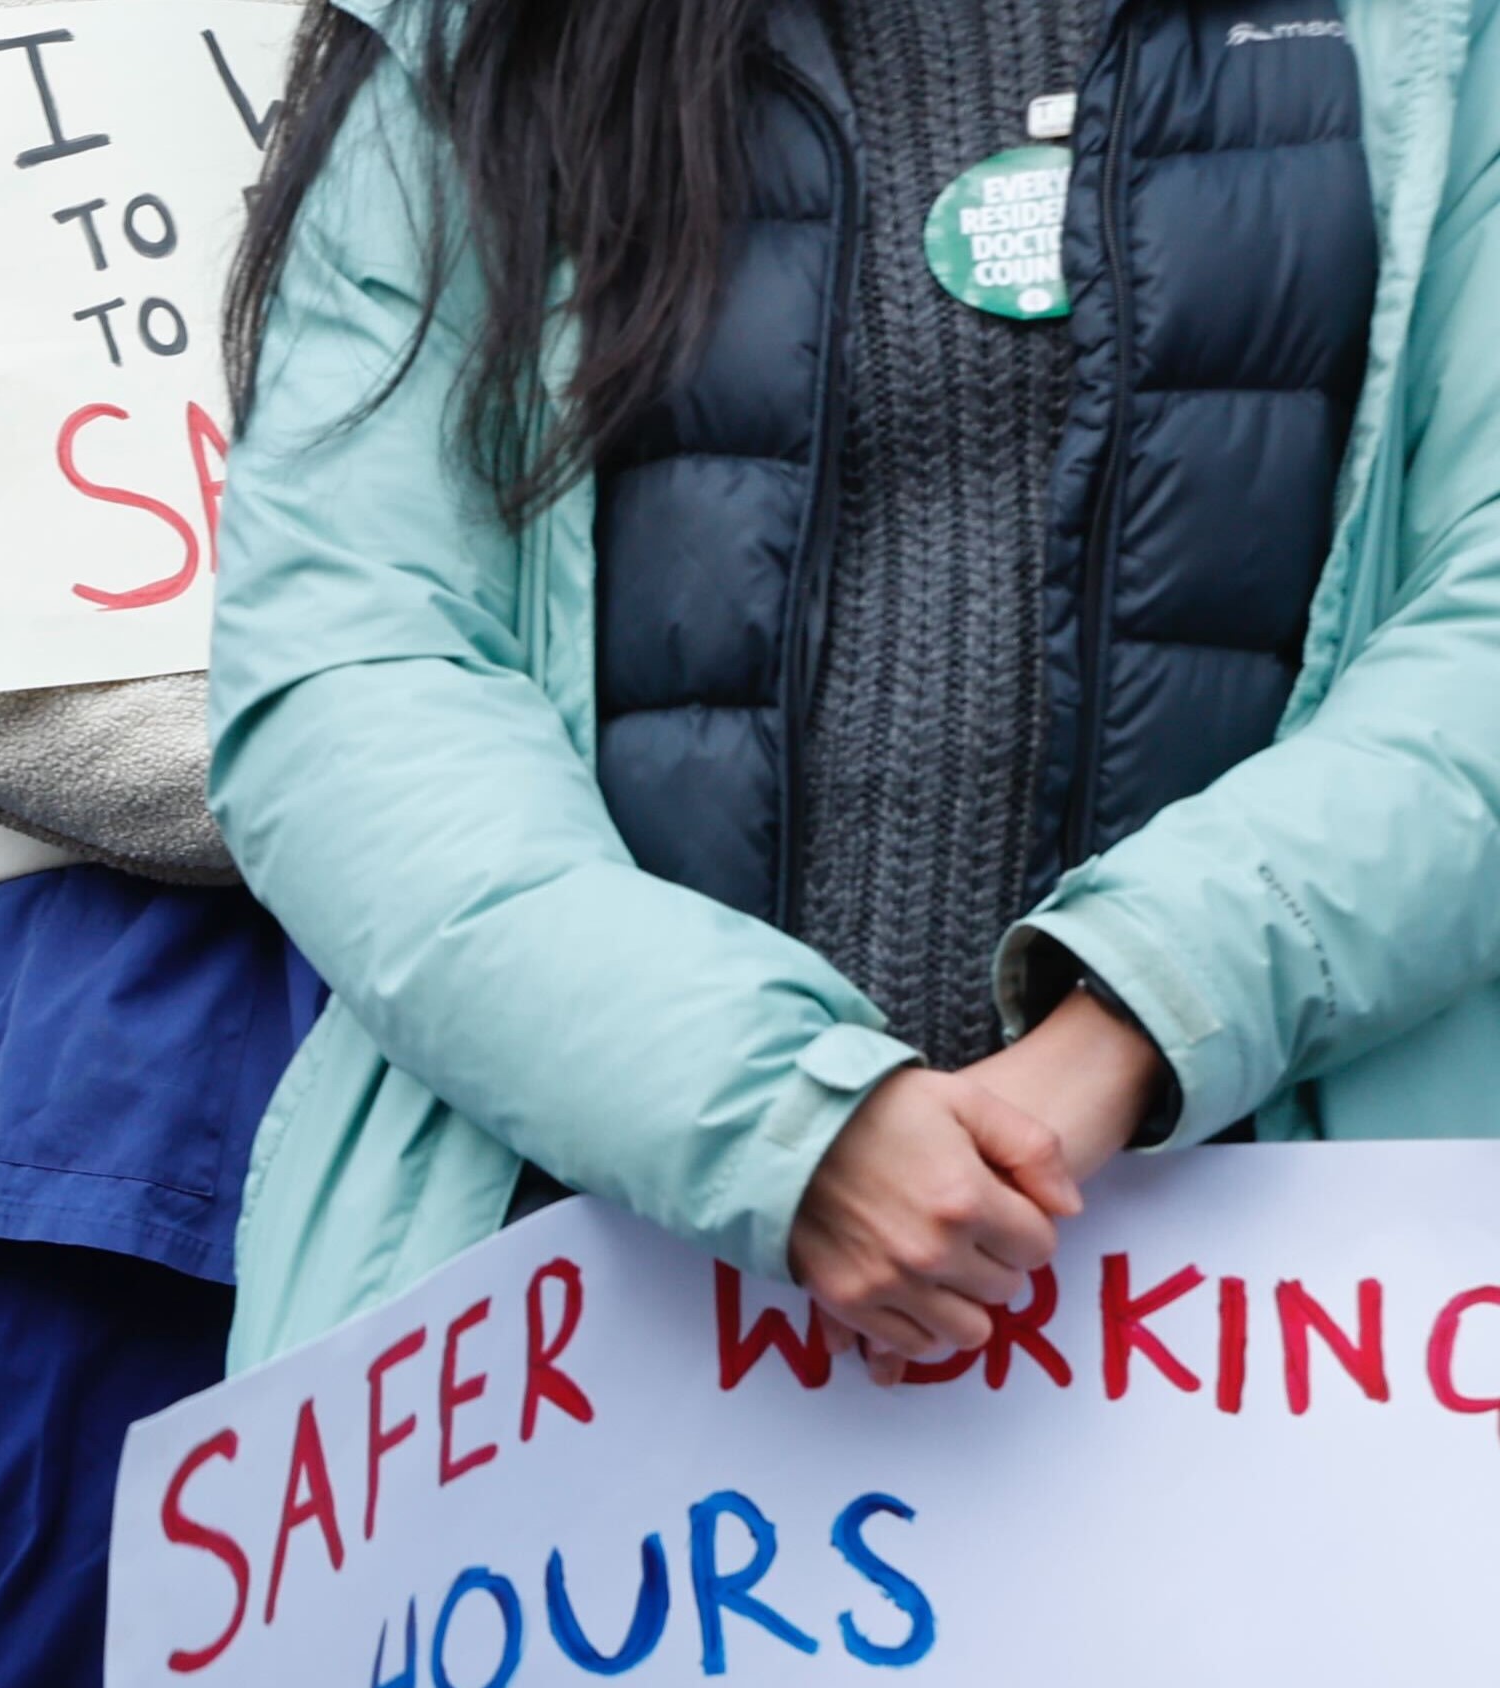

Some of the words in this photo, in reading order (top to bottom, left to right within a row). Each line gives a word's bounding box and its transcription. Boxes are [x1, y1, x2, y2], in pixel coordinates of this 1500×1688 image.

[52, 193, 178, 272] TO
[73, 297, 189, 367] TO
[160, 1258, 594, 1674] SAFER
